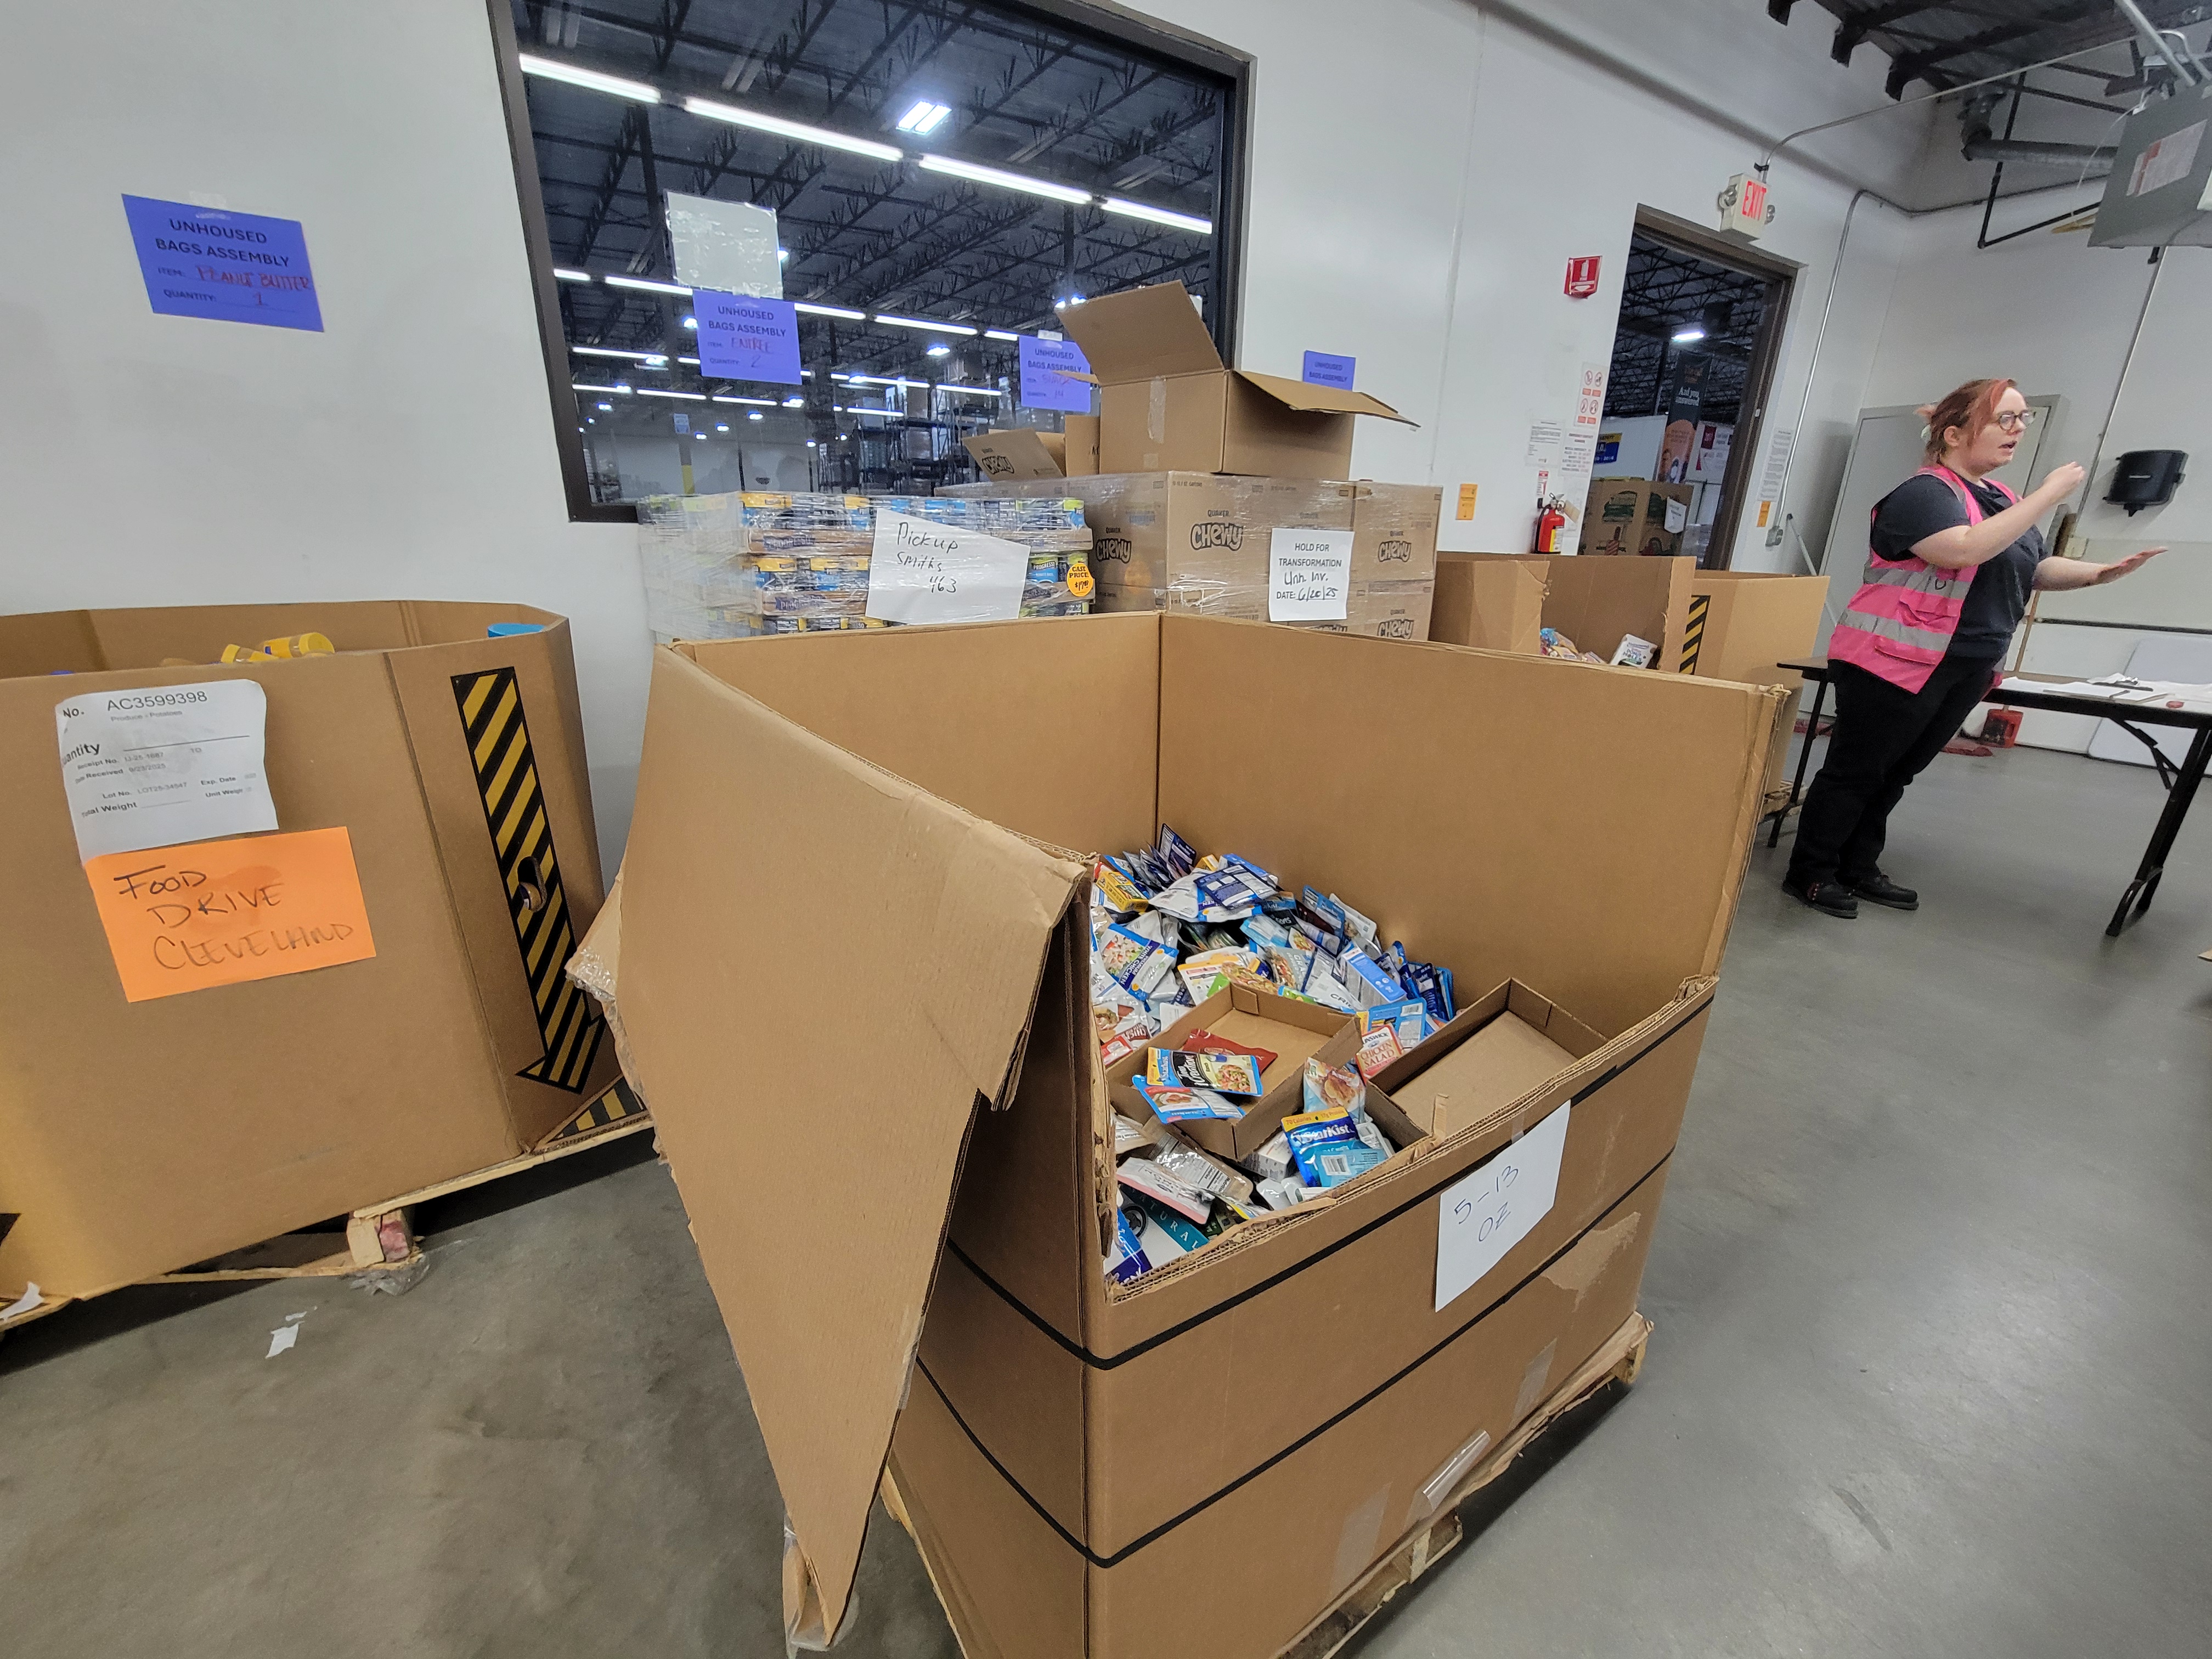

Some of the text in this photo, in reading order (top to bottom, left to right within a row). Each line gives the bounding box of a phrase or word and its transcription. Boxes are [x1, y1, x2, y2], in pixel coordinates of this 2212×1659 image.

[1742, 180, 1767, 221] EXIT
[170, 219, 267, 243] UNHOUSED
[155, 238, 289, 267] BAGS ASSEMBLY
[718, 306, 774, 320] UNHOUSED
[709, 320, 786, 337] BAGS ASSEMBLY
[1035, 348, 1074, 359] UNHOUSED
[1028, 360, 1081, 372] BAGS ASSEMBLY
[1190, 522, 1244, 551] CHEWY
[1096, 538, 1131, 563] CHEWY
[1295, 543, 1329, 552] HOLD FOR
[1378, 540, 1412, 562] CHEWY
[1033, 561, 1056, 571] PROGRESSO
[1278, 558, 1342, 567] TRANSFORMATION
[929, 575, 957, 593] 463
[1276, 591, 1296, 600] DATE:
[1378, 619, 1414, 639] CHEWY
[63, 691, 207, 718] No. AC3599398
[63, 743, 100, 765] uantity
[86, 769, 123, 778] Received
[101, 802, 137, 812] Weight
[114, 865, 207, 899] FOOD
[146, 883, 284, 928] DRIVE
[1119, 960, 1140, 985] CHICKEN
[1361, 1042, 1392, 1060] CHICKEN
[1364, 1049, 1395, 1067] SALAD
[1304, 1124, 1350, 1142] StarKist
